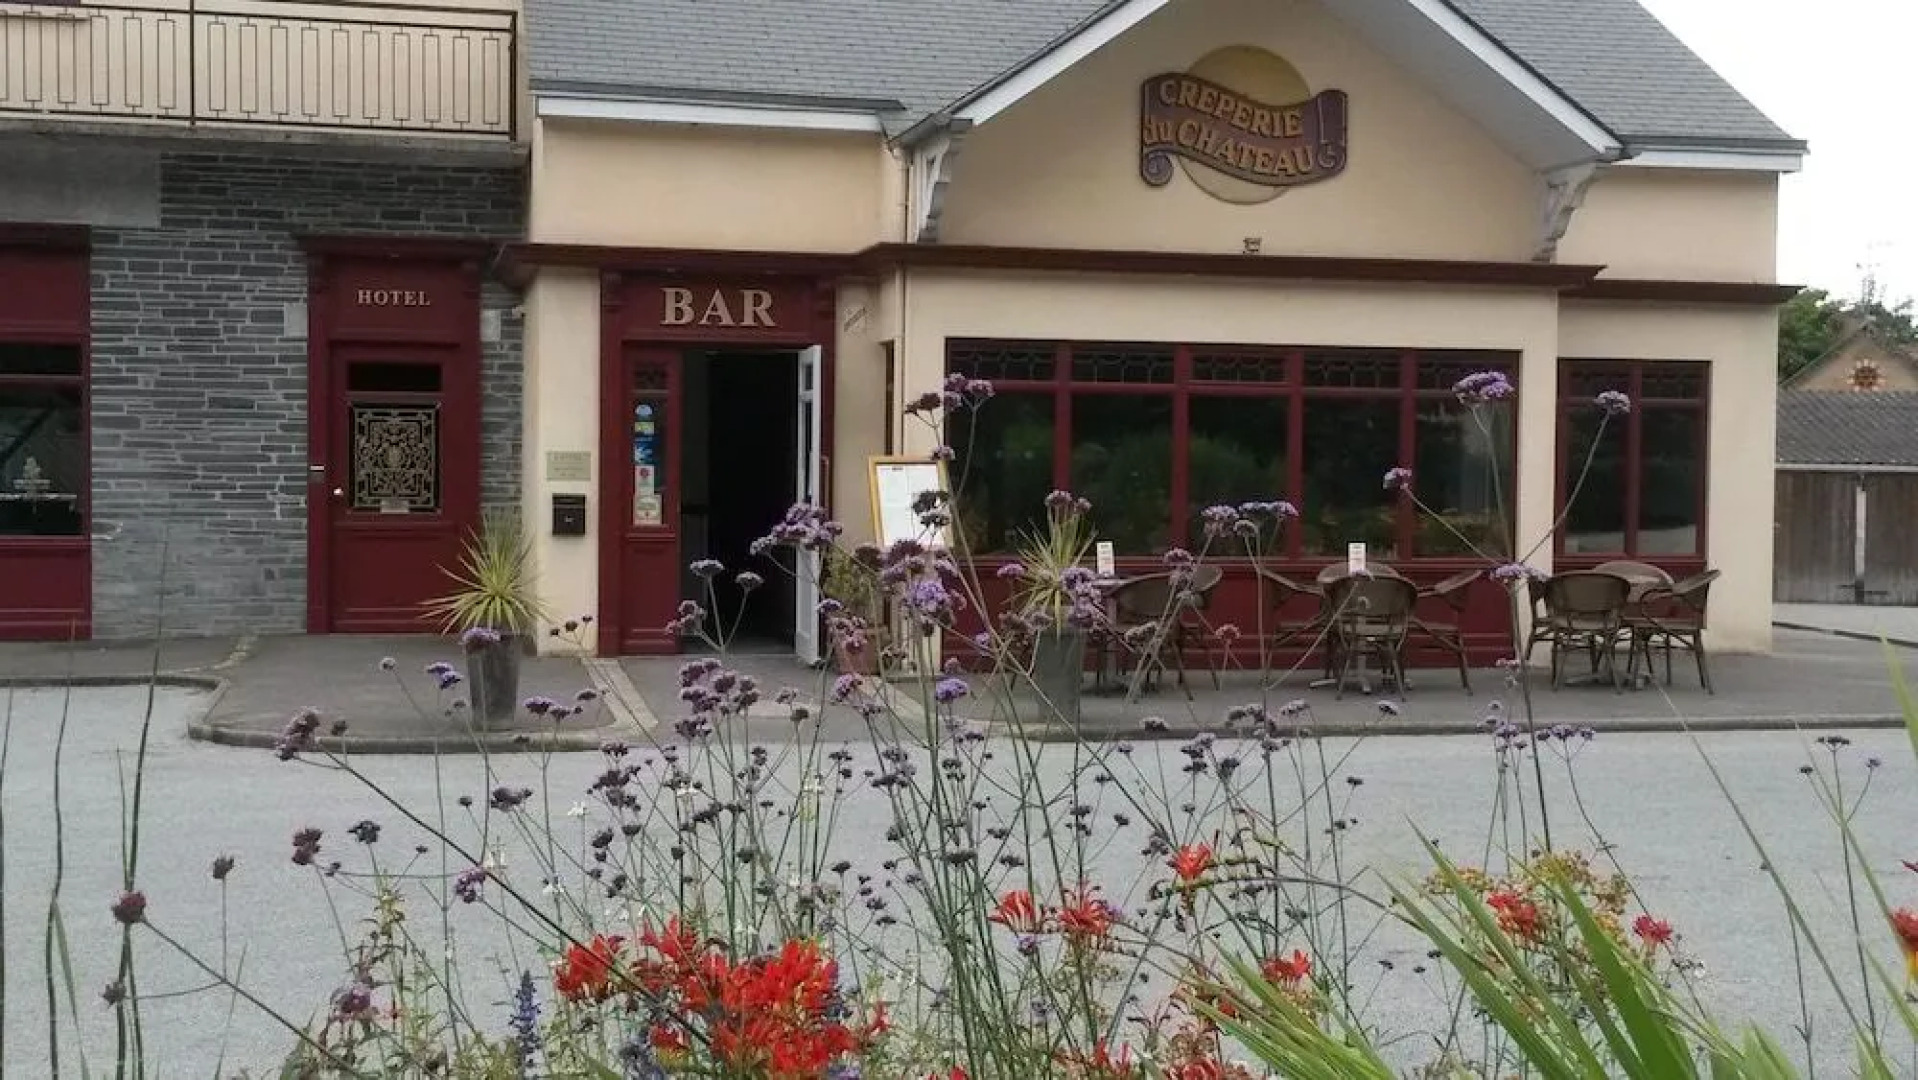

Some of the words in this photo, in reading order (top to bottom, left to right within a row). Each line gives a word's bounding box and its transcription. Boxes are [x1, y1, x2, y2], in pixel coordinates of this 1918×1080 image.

[1160, 79, 1303, 137] CREPERIE
[1177, 120, 1314, 176] CHATEAU
[357, 289, 431, 306] HOTEL
[661, 287, 777, 328] BAR
